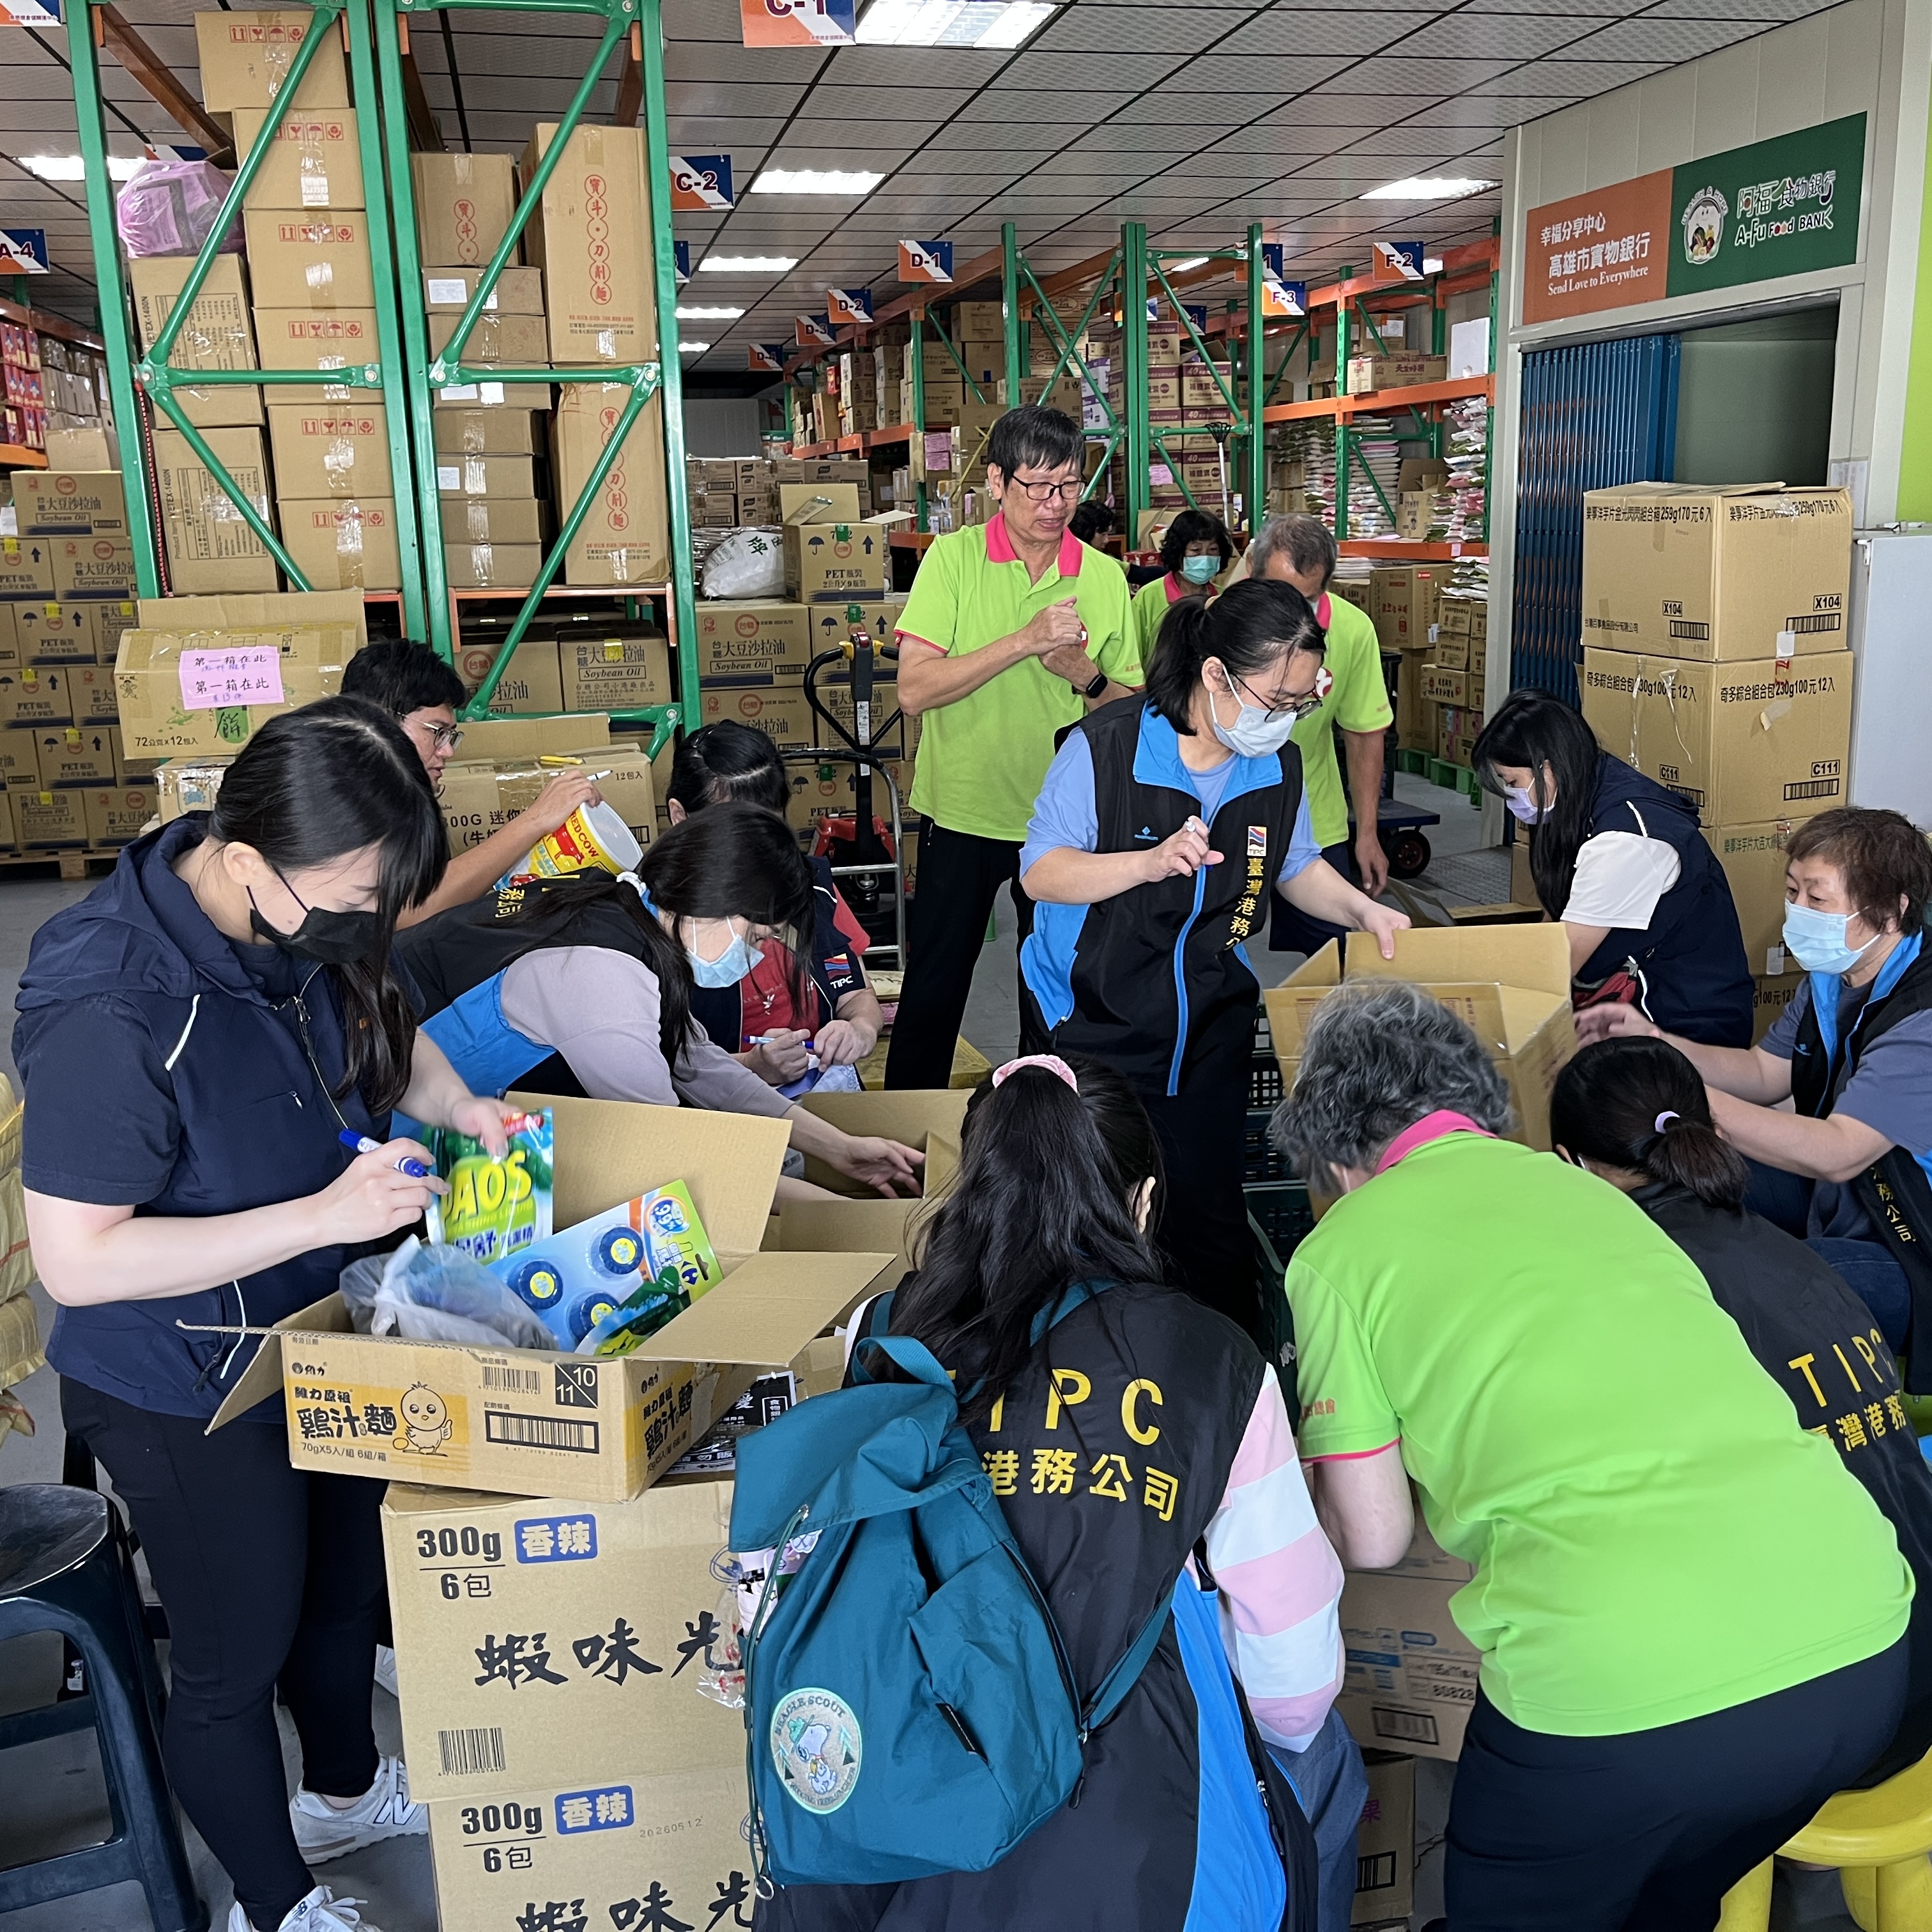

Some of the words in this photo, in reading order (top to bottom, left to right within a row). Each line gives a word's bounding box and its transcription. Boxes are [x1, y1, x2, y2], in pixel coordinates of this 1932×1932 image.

[676, 171, 717, 191] C-2
[1798, 204, 1834, 231] BANK
[1540, 211, 1606, 247] 幸福分享中心
[0, 243, 33, 257] A-4
[1549, 232, 1650, 279] 高雄市實物銀行
[911, 253, 941, 268] D-1
[1385, 254, 1413, 268] F-2
[1548, 280, 1567, 295] Send
[1569, 279, 1588, 292] Love
[1590, 277, 1598, 287] to
[1600, 265, 1649, 285] Everywhere
[1271, 291, 1296, 303] F-3
[838, 300, 863, 311] D-2
[806, 324, 828, 335] D-3
[756, 352, 776, 361] D-4
[1188, 367, 1199, 375] 40
[46, 496, 102, 510] 大豆沙拉油
[1663, 602, 1682, 615] X104
[1815, 594, 1840, 609] X104
[723, 639, 785, 657] 大豆沙拉油
[194, 654, 267, 667] 第一箱在此
[714, 661, 751, 671] Soybean
[754, 660, 767, 670] Oil
[584, 668, 623, 678] Soybean
[626, 667, 641, 677] Oil
[195, 677, 269, 694] 第一箱在此
[1587, 671, 1697, 703] 奇多綜合組合包30g100元12入
[615, 770, 643, 781] 12包入
[1661, 767, 1678, 780] C111
[1813, 761, 1839, 776] C111
[830, 976, 854, 989] TIPC
[573, 1367, 596, 1387] 10
[556, 1384, 574, 1403] 11
[946, 1368, 1163, 1445] IPC
[981, 1448, 1179, 1522] 港務公司
[417, 1526, 501, 1562] 300g
[521, 1521, 592, 1558] 香辣
[440, 1572, 492, 1600] 6包
[775, 1697, 805, 1736] BEAGLE
[808, 1695, 846, 1718] SCOUT
[461, 1802, 542, 1834] 300g
[562, 1791, 629, 1828] 香辣
[640, 1818, 702, 1839] 20260512
[483, 1846, 533, 1873] 6包
